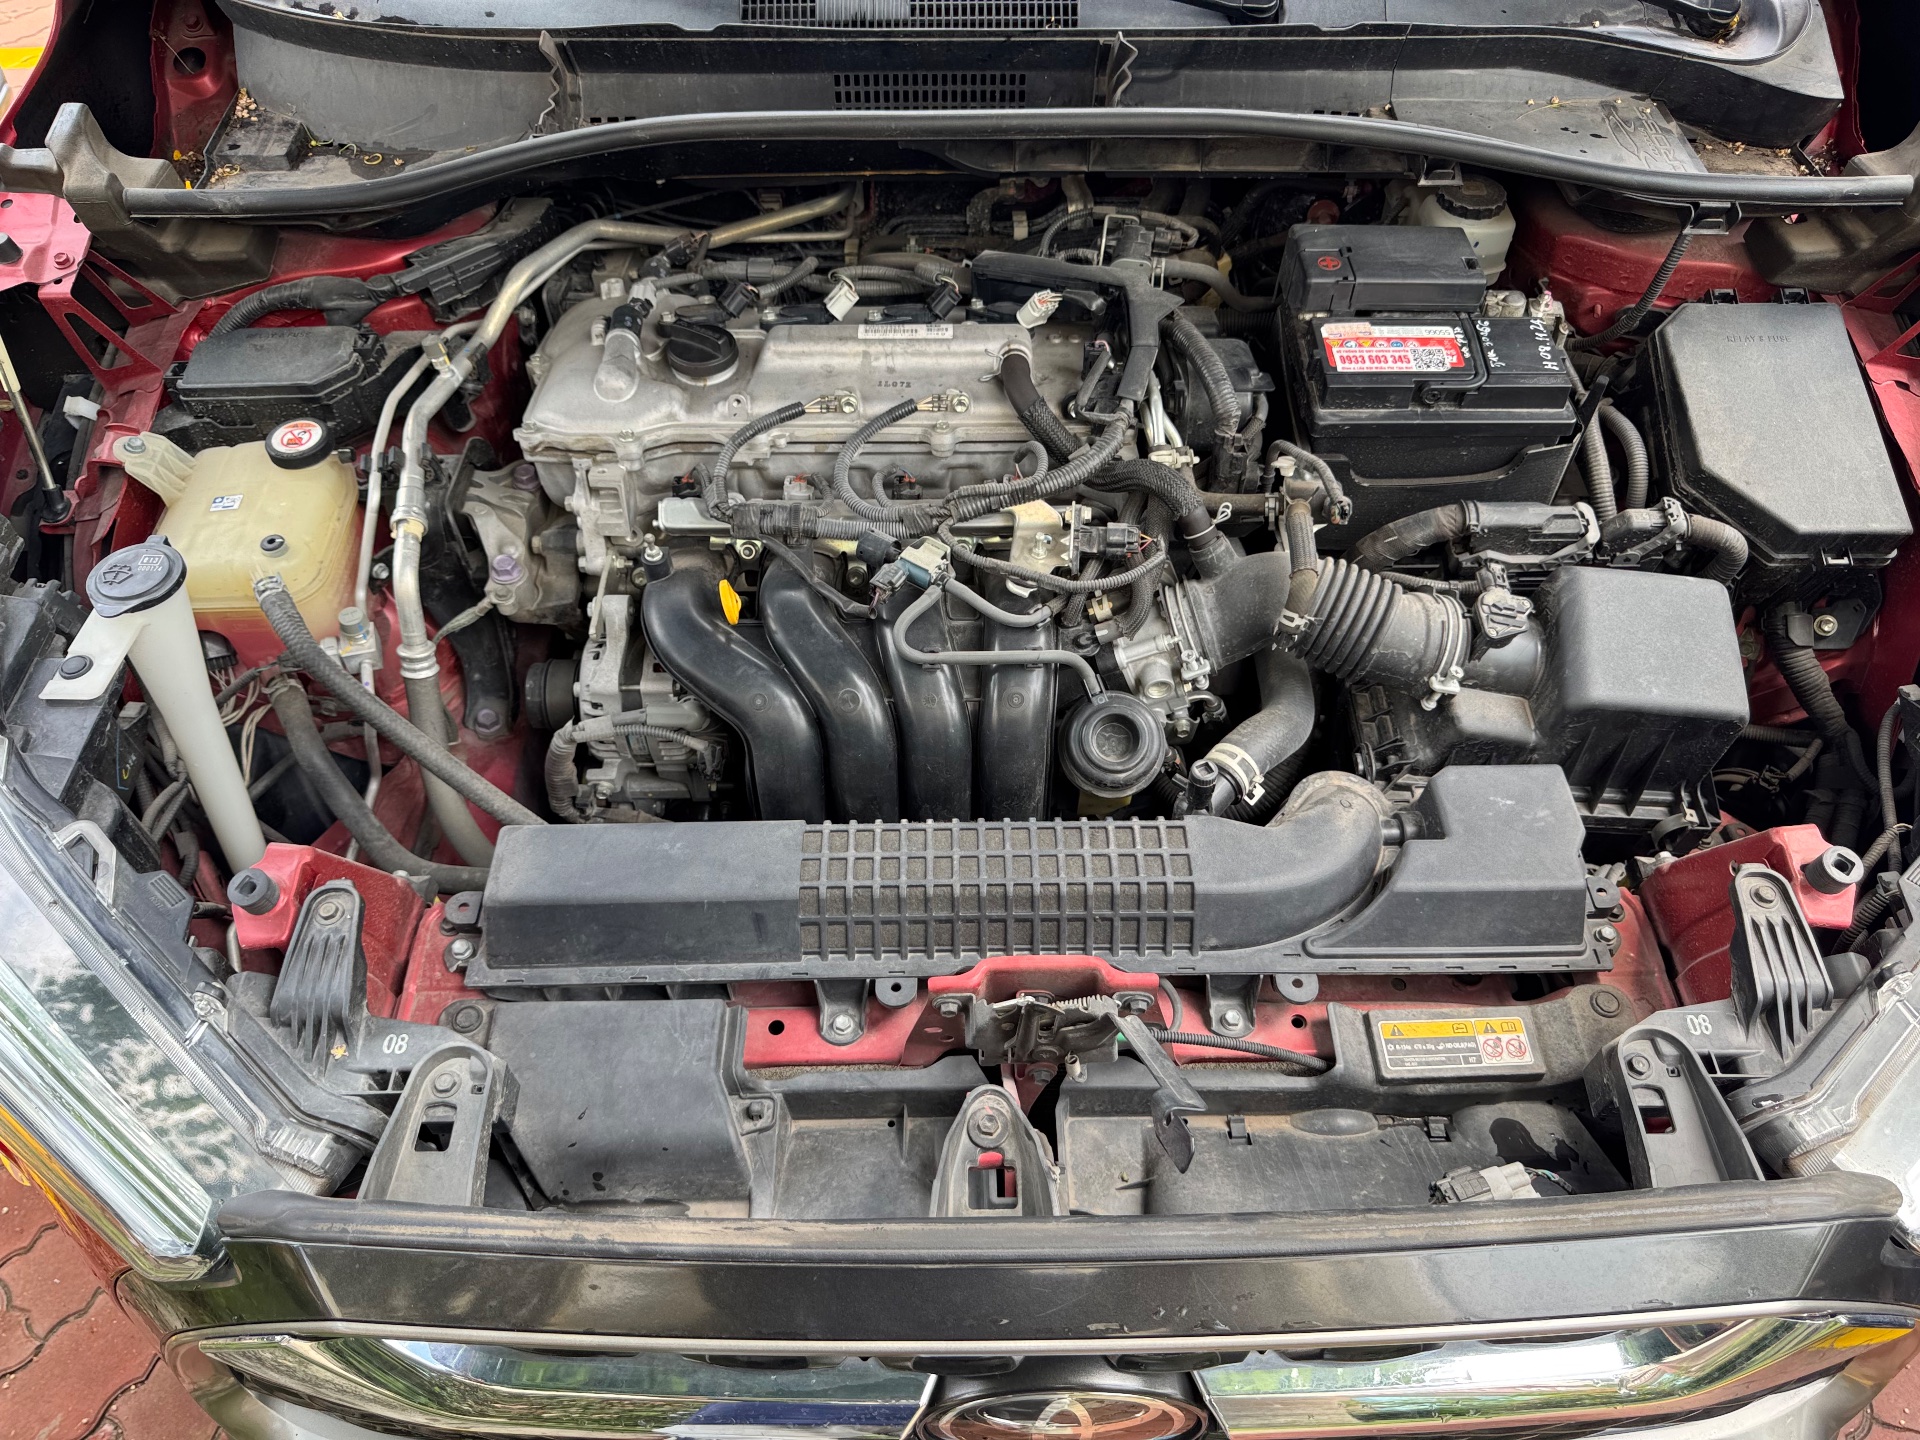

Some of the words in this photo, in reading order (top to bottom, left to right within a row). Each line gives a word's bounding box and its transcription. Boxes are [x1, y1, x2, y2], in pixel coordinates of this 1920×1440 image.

[1339, 354, 1366, 365] 0933
[1368, 354, 1388, 365] 603
[1390, 354, 1411, 364] 345
[1686, 1014, 1712, 1035] 08
[383, 1034, 409, 1054] 08
